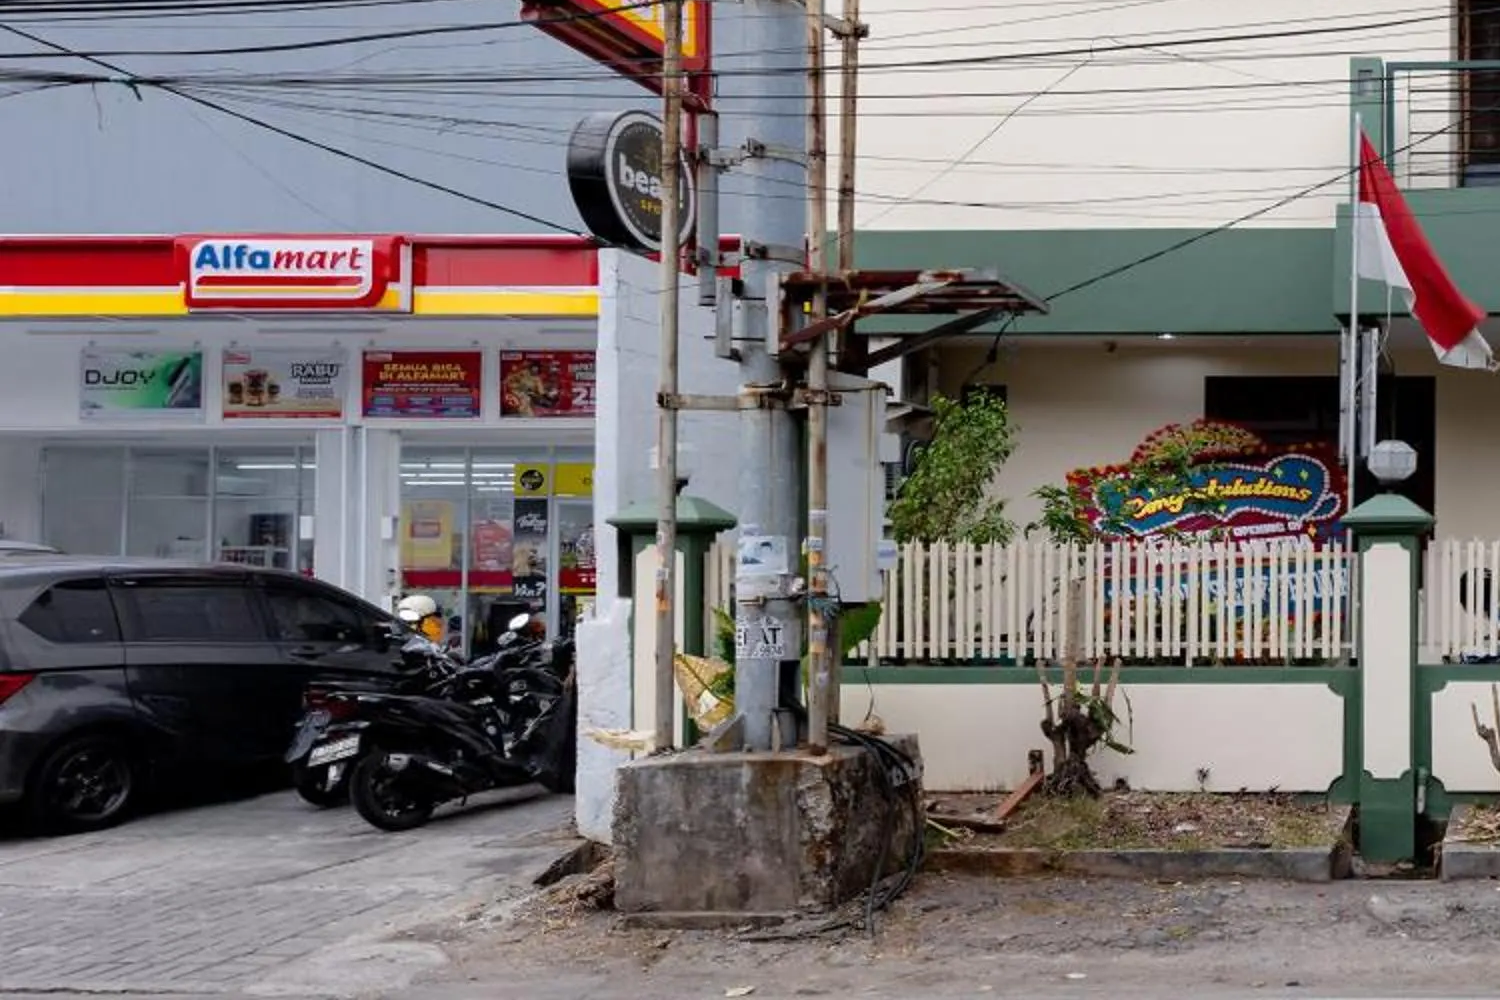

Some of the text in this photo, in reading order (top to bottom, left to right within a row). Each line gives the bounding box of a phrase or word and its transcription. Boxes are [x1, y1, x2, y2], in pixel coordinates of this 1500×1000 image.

[619, 152, 680, 200] bea
[195, 244, 364, 270] Alfamart
[84, 369, 156, 386] DJOY
